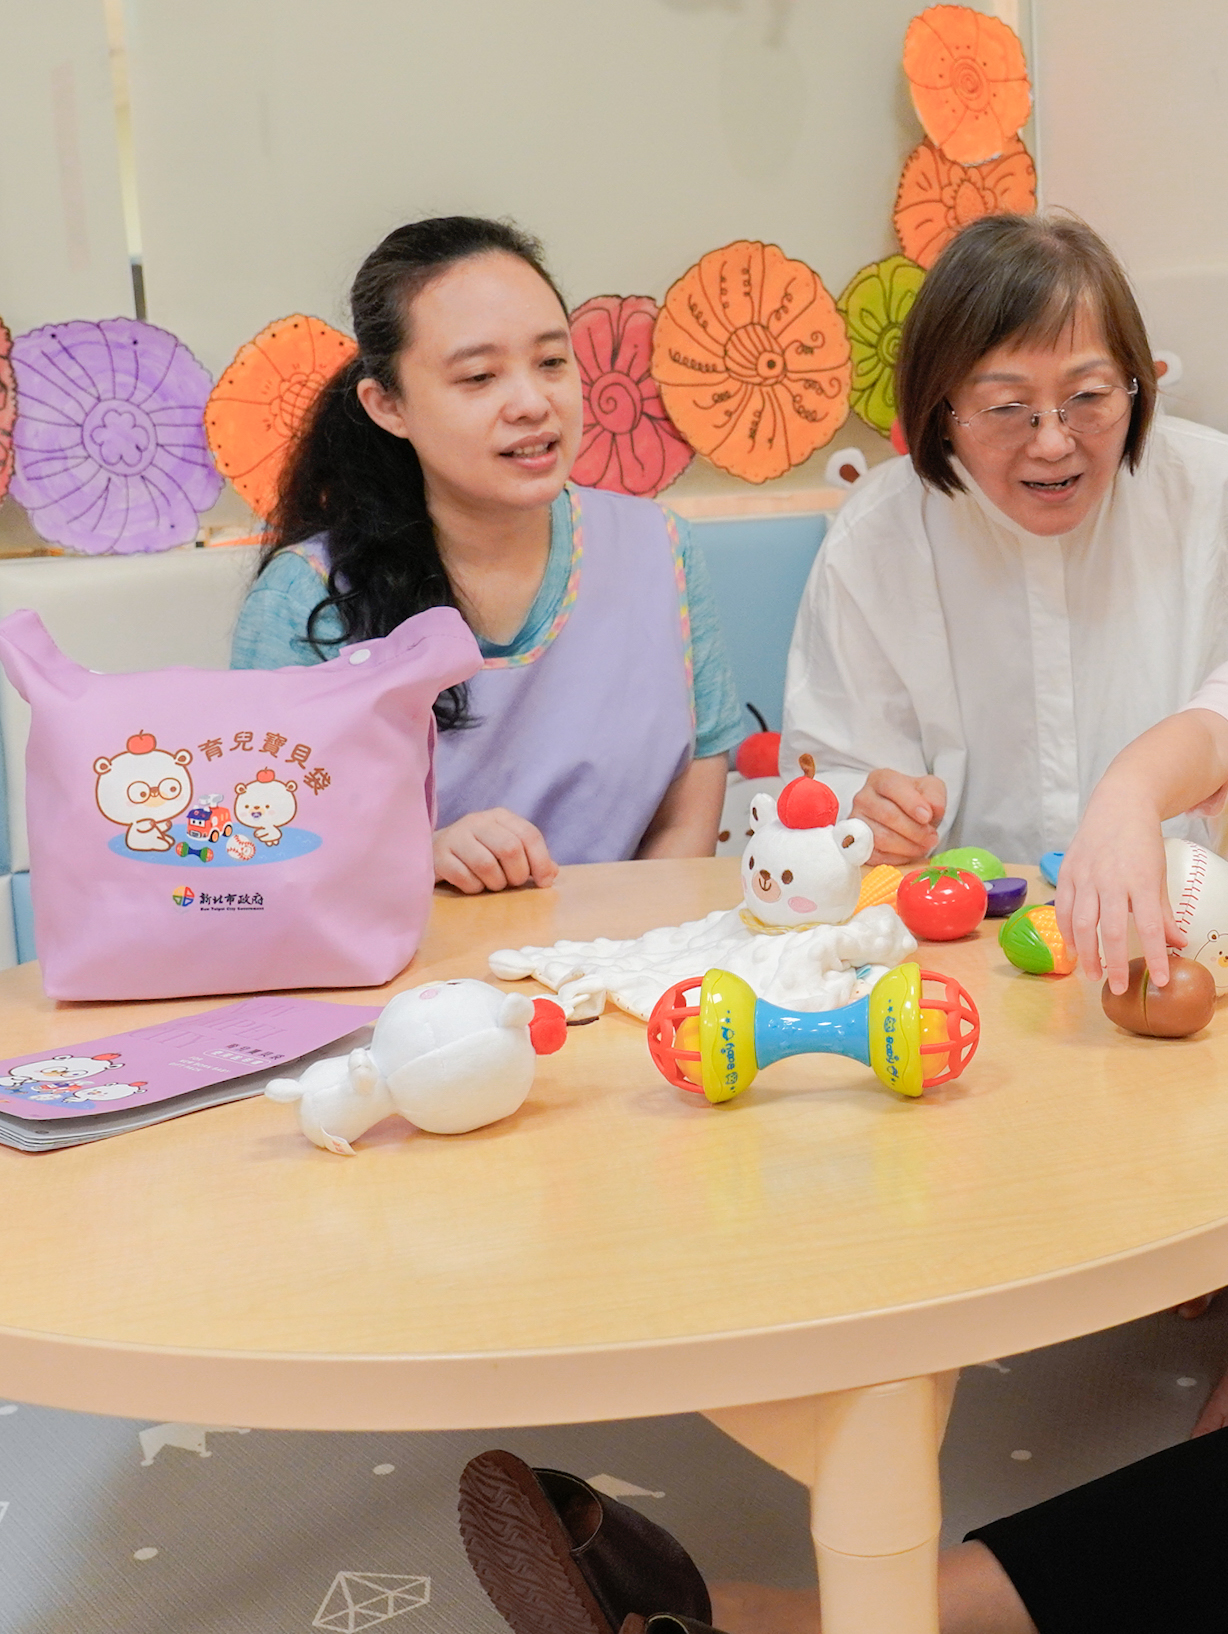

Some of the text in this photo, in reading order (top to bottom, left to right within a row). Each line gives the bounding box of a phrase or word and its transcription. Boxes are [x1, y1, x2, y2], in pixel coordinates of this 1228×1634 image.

[197, 731, 331, 796] 育兒寶貝袋
[199, 892, 264, 906] 新北市政府
[885, 1036, 895, 1064] Baby
